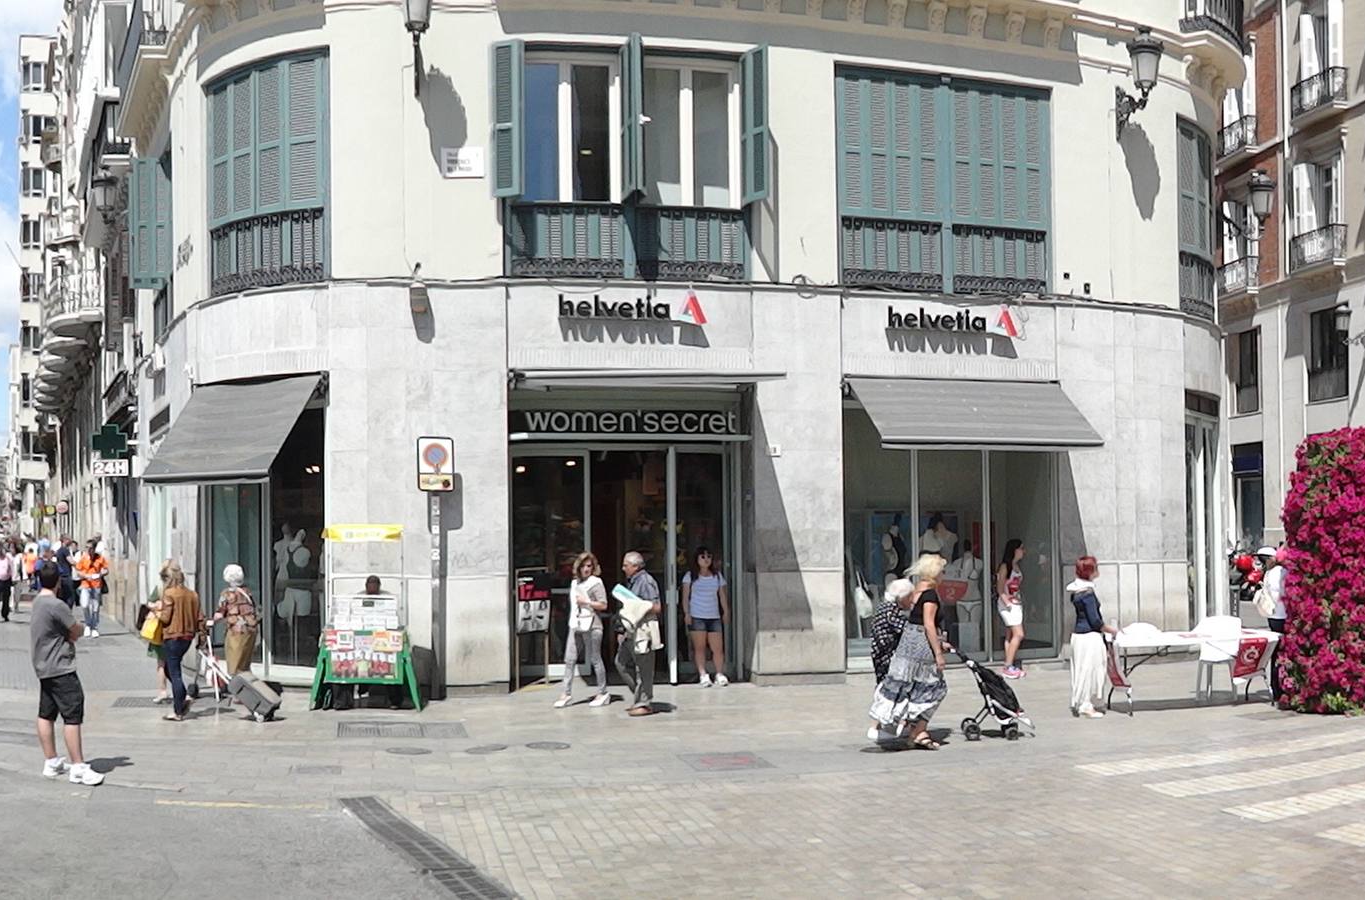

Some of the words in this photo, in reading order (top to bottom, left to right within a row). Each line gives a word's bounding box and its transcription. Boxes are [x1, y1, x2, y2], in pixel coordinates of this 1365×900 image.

[558, 294, 670, 320] helvetia
[887, 305, 986, 332] helvetia
[526, 409, 736, 433] women'secret
[94, 461, 126, 475] 24H
